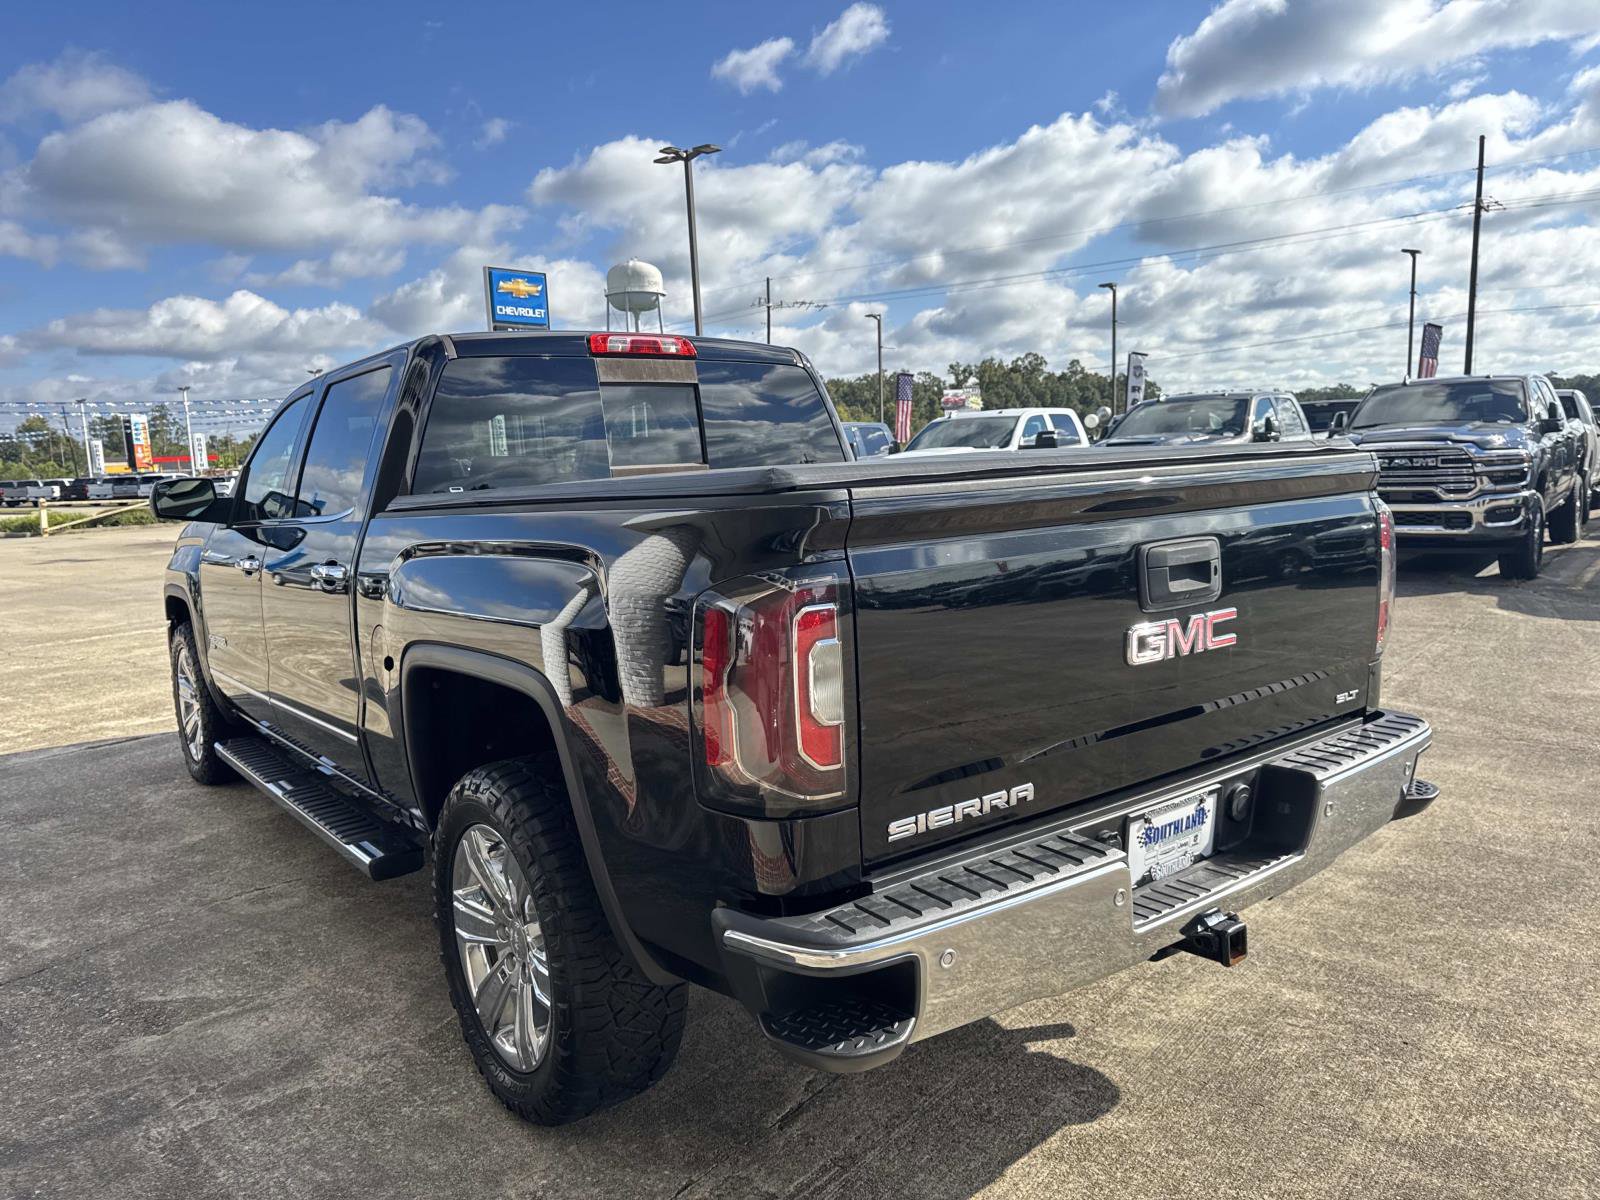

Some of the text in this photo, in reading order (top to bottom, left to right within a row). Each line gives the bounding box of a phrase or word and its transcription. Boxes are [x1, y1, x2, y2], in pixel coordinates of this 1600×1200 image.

[496, 305, 545, 318] CHEVROLET
[1126, 607, 1238, 666] GMC
[1336, 689, 1359, 704] SLT
[887, 782, 1035, 843] SIERRA
[1144, 805, 1206, 847] SOUTHLAND
